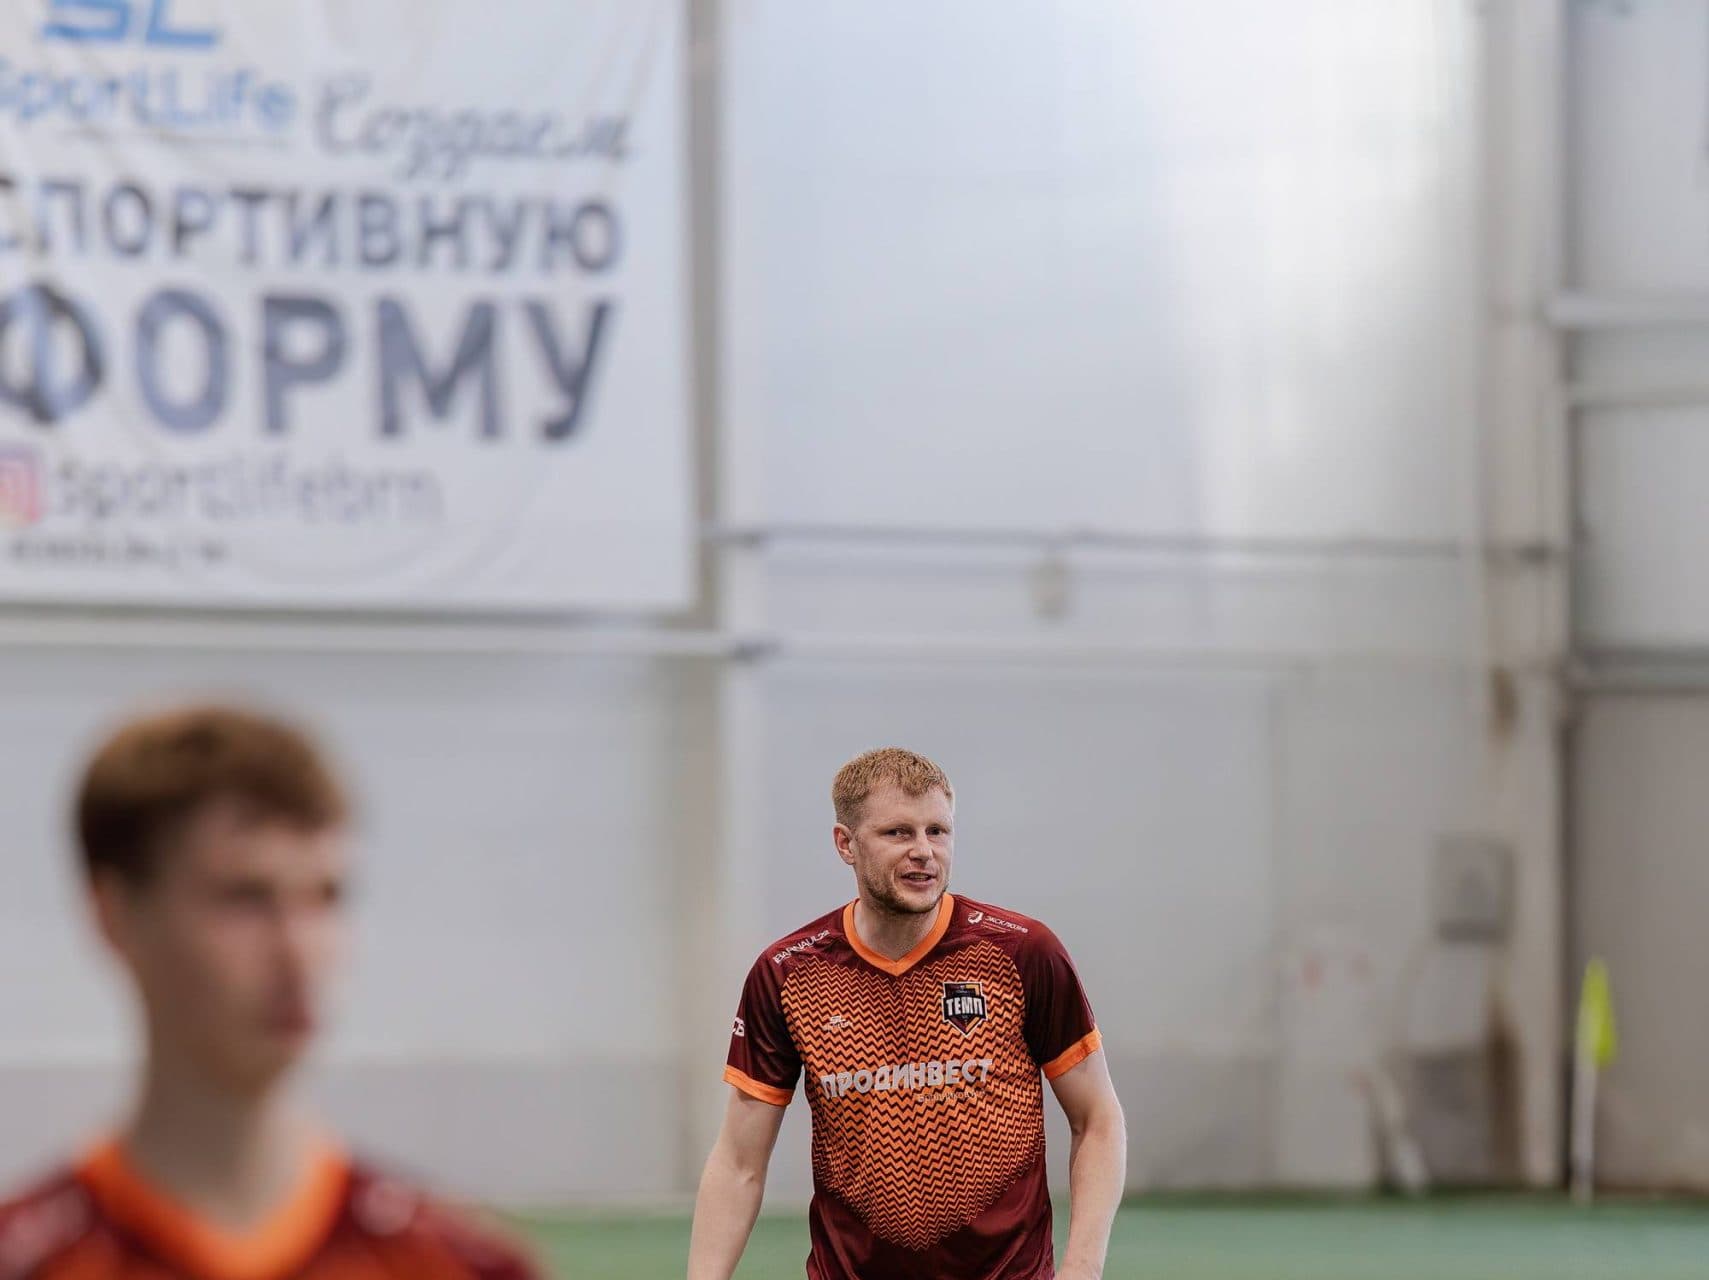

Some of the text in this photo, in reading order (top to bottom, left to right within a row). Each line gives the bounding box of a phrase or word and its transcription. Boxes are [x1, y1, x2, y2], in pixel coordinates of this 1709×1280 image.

[0, 282, 613, 445] ФОРМУ
[946, 996, 983, 1016] ТЕМП
[820, 1059, 992, 1098] ПРОДИНВЕСТ
